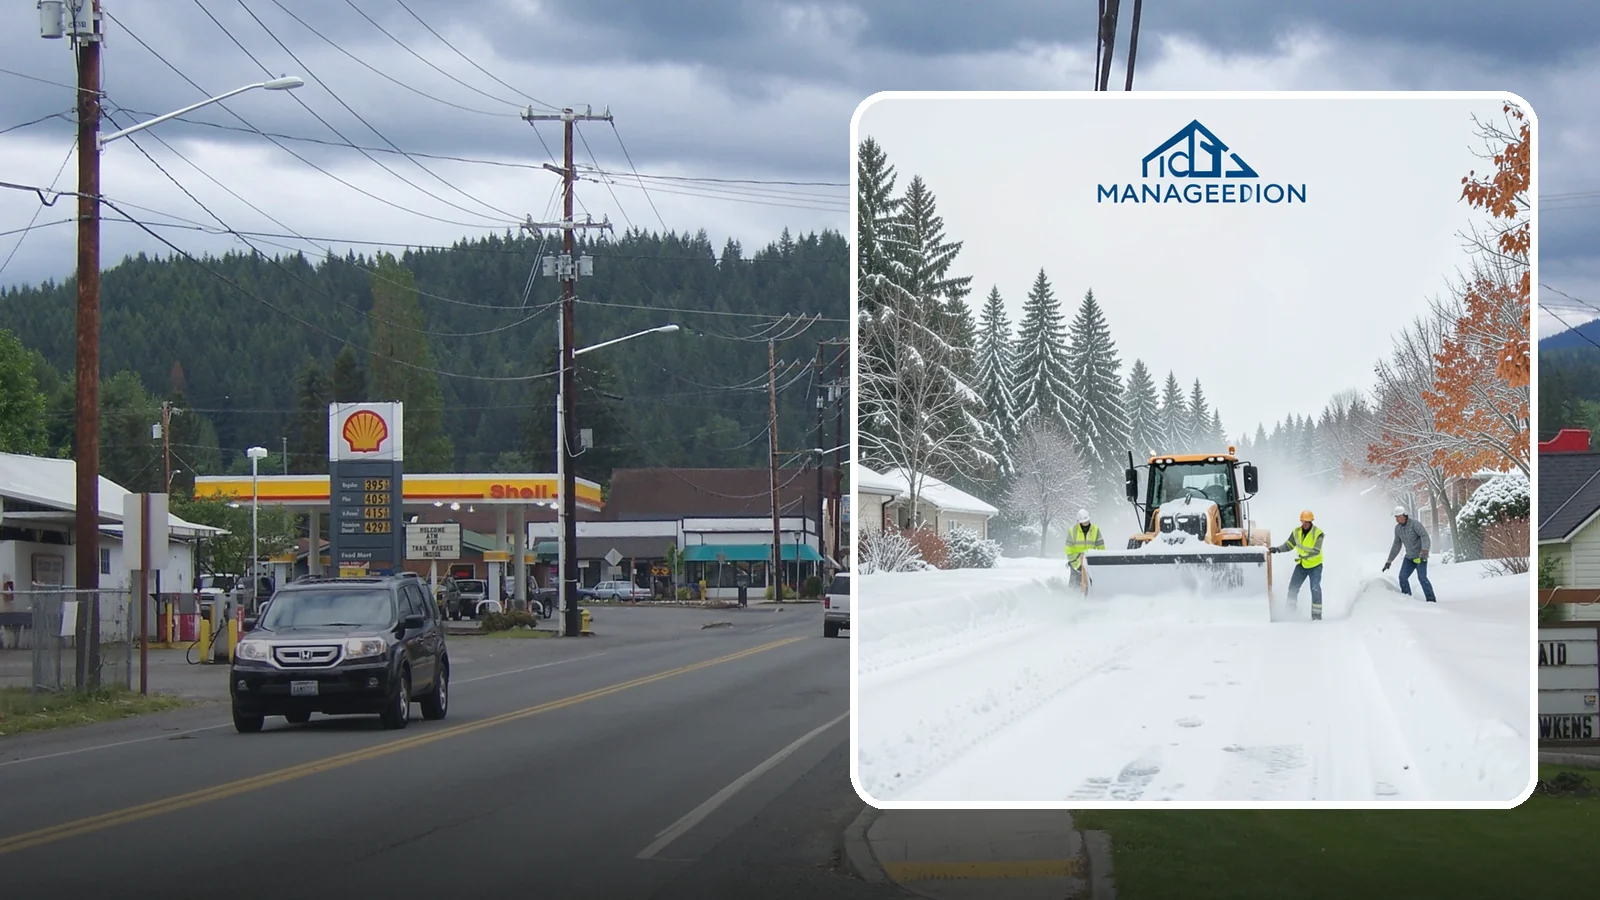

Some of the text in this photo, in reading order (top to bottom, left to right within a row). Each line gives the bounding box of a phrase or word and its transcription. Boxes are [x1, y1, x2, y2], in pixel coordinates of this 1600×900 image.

[365, 480, 383, 490] 395
[490, 484, 547, 499] Shell
[365, 494, 383, 504] 405
[365, 508, 383, 518] 415
[365, 522, 383, 532] 429
